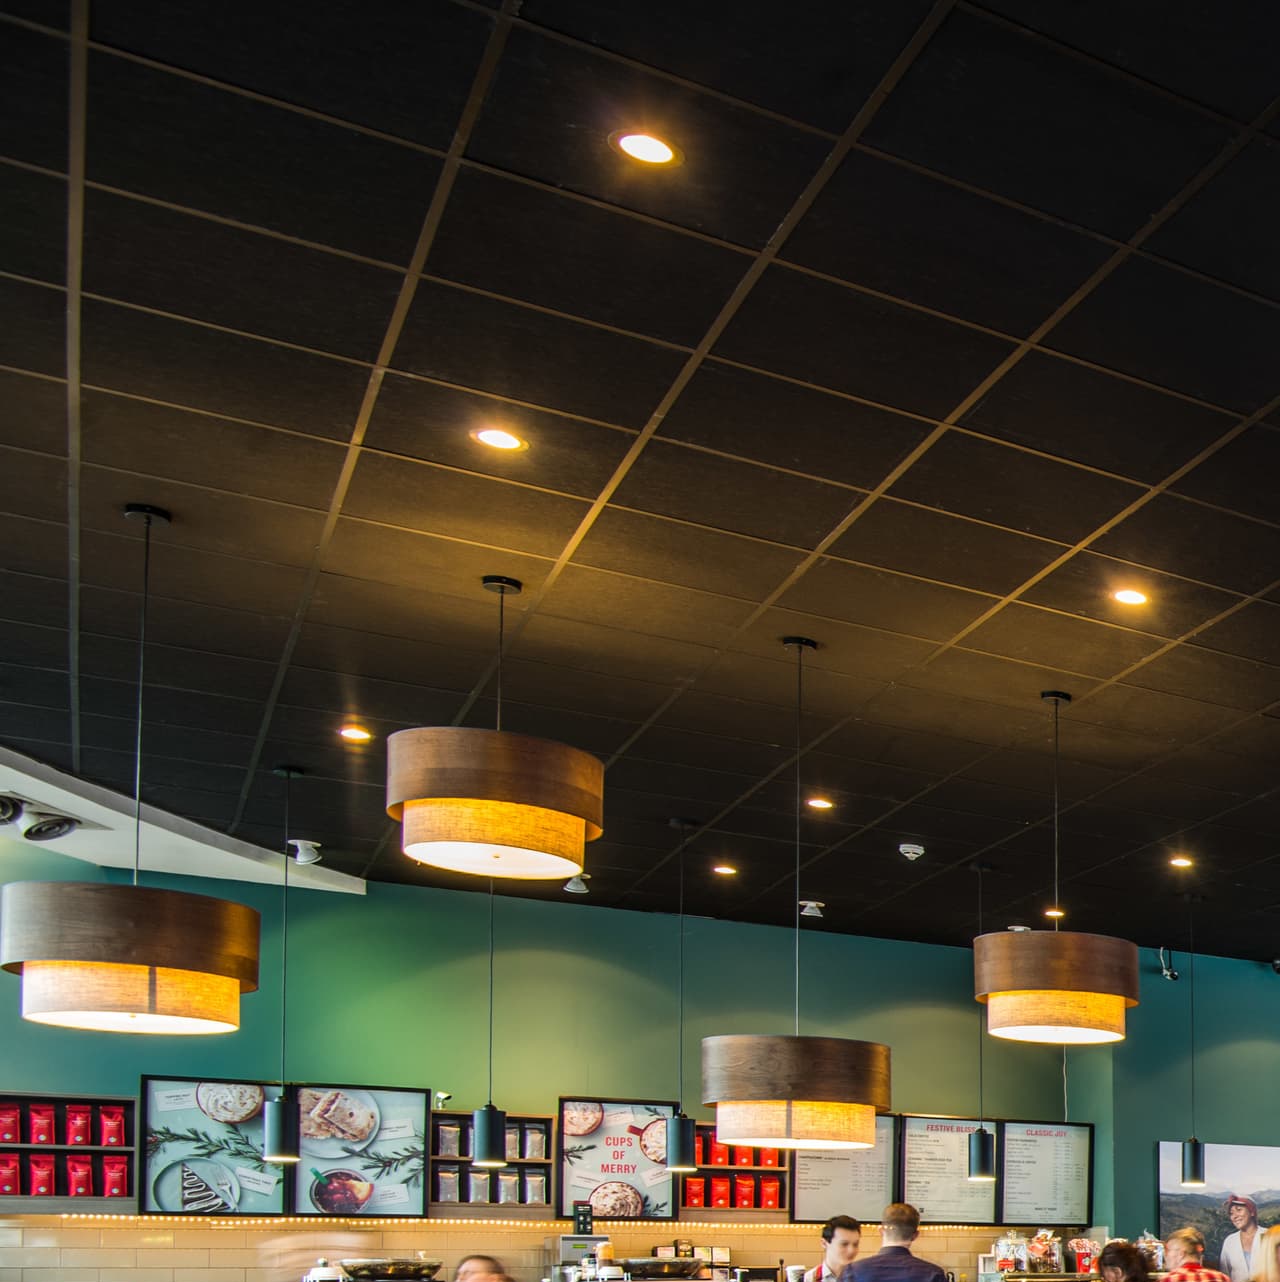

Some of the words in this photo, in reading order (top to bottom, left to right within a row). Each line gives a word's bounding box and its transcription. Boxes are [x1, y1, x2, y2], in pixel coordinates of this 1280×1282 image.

[926, 1124, 953, 1132] FESTIVE
[1026, 1129, 1053, 1137] CLASSIC
[605, 1136, 633, 1147] CUPS
[612, 1150, 626, 1160] OF
[600, 1163, 637, 1174] MERRY
